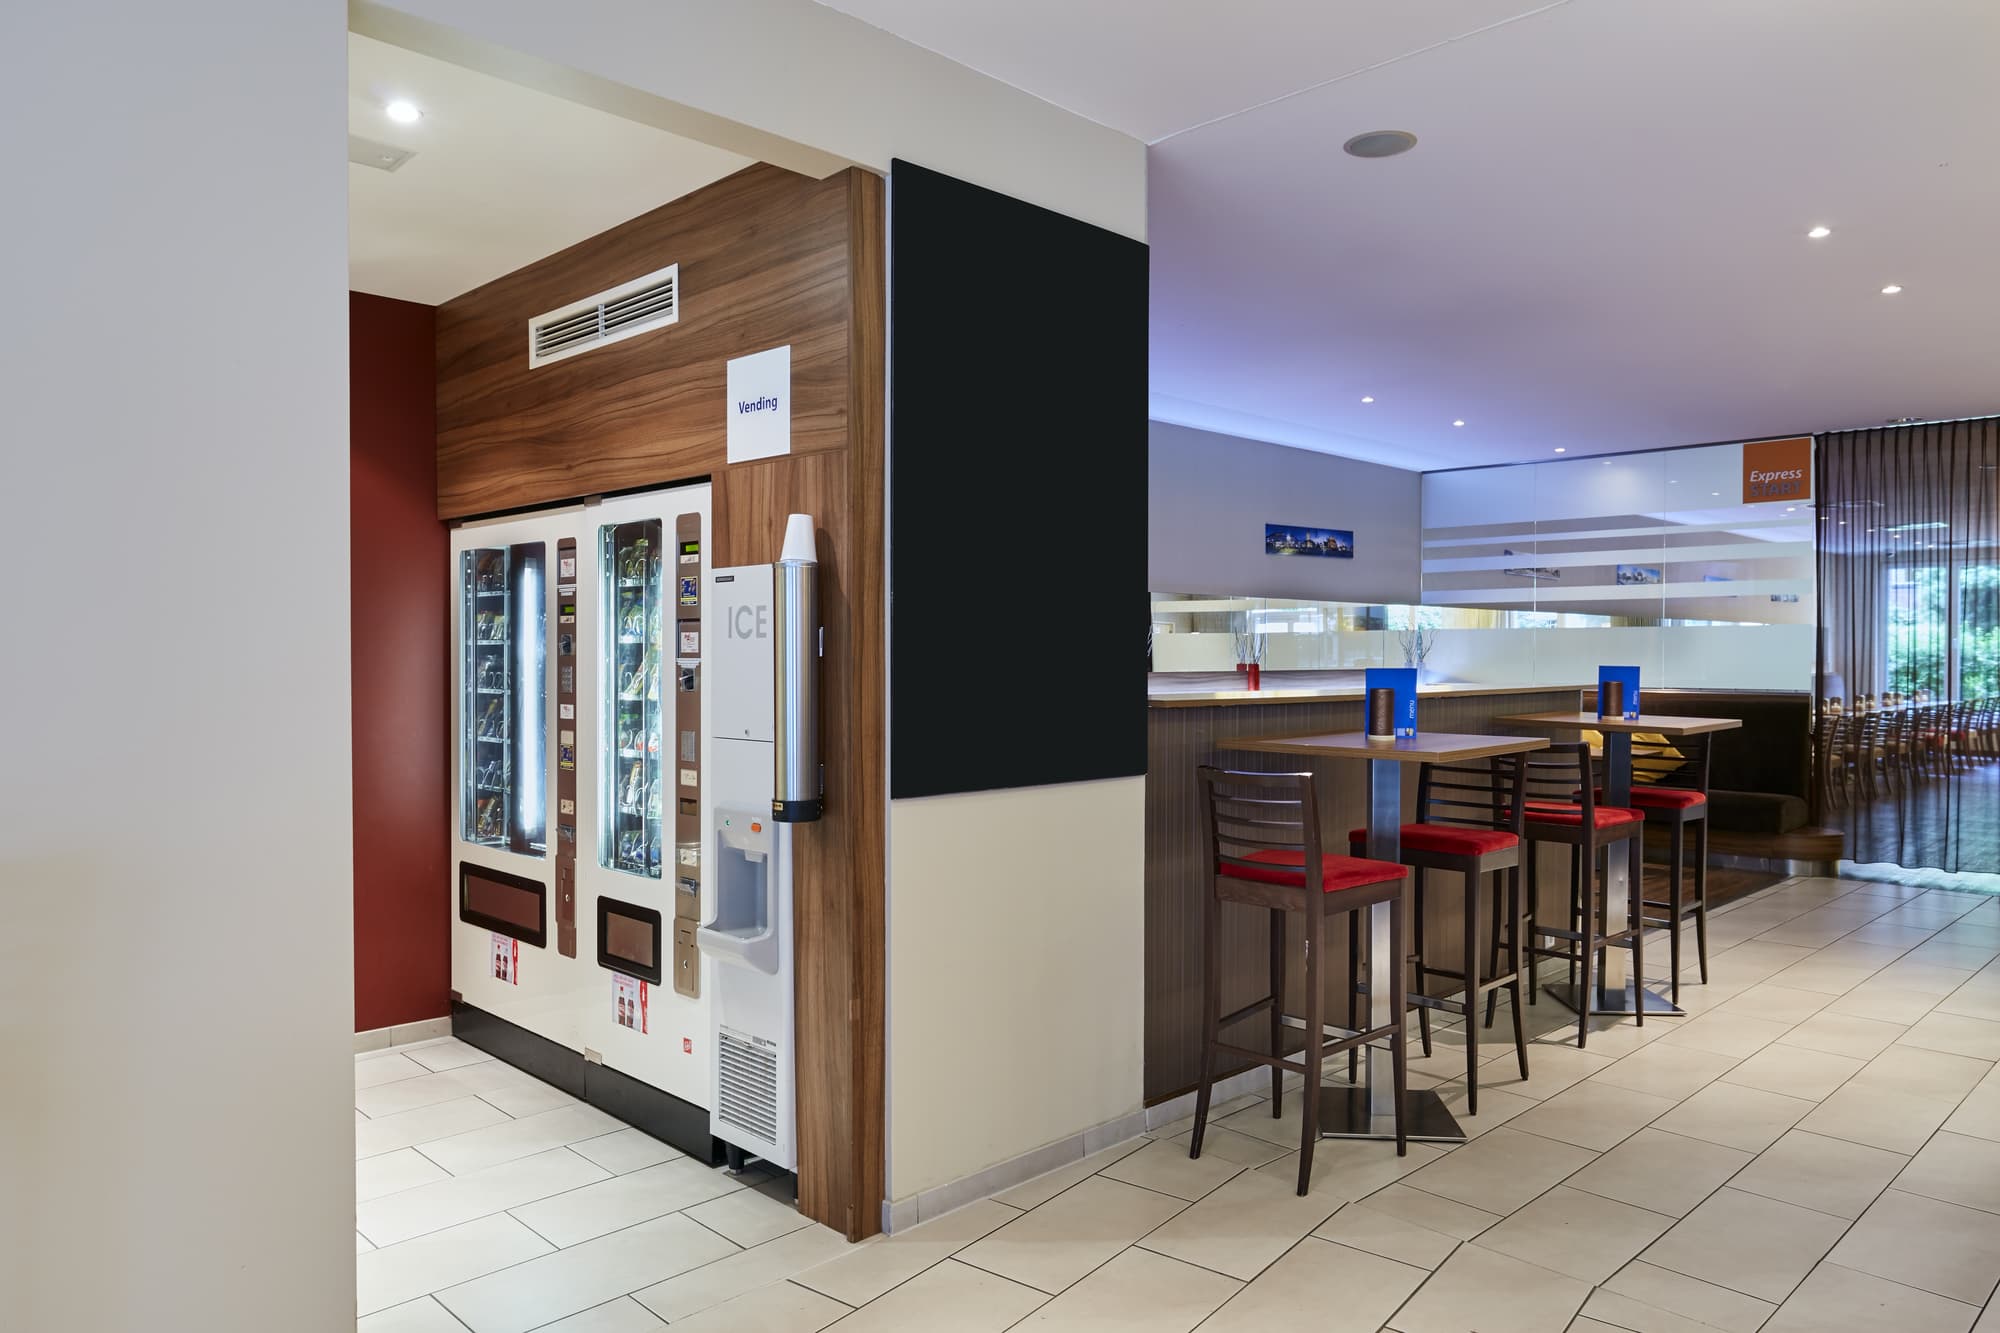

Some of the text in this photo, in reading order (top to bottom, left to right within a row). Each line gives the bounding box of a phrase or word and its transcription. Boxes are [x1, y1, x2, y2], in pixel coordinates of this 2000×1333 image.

[739, 397, 778, 414] Vending
[1749, 469, 1803, 483] Express
[1750, 481, 1803, 496] START
[728, 605, 767, 639] ICE
